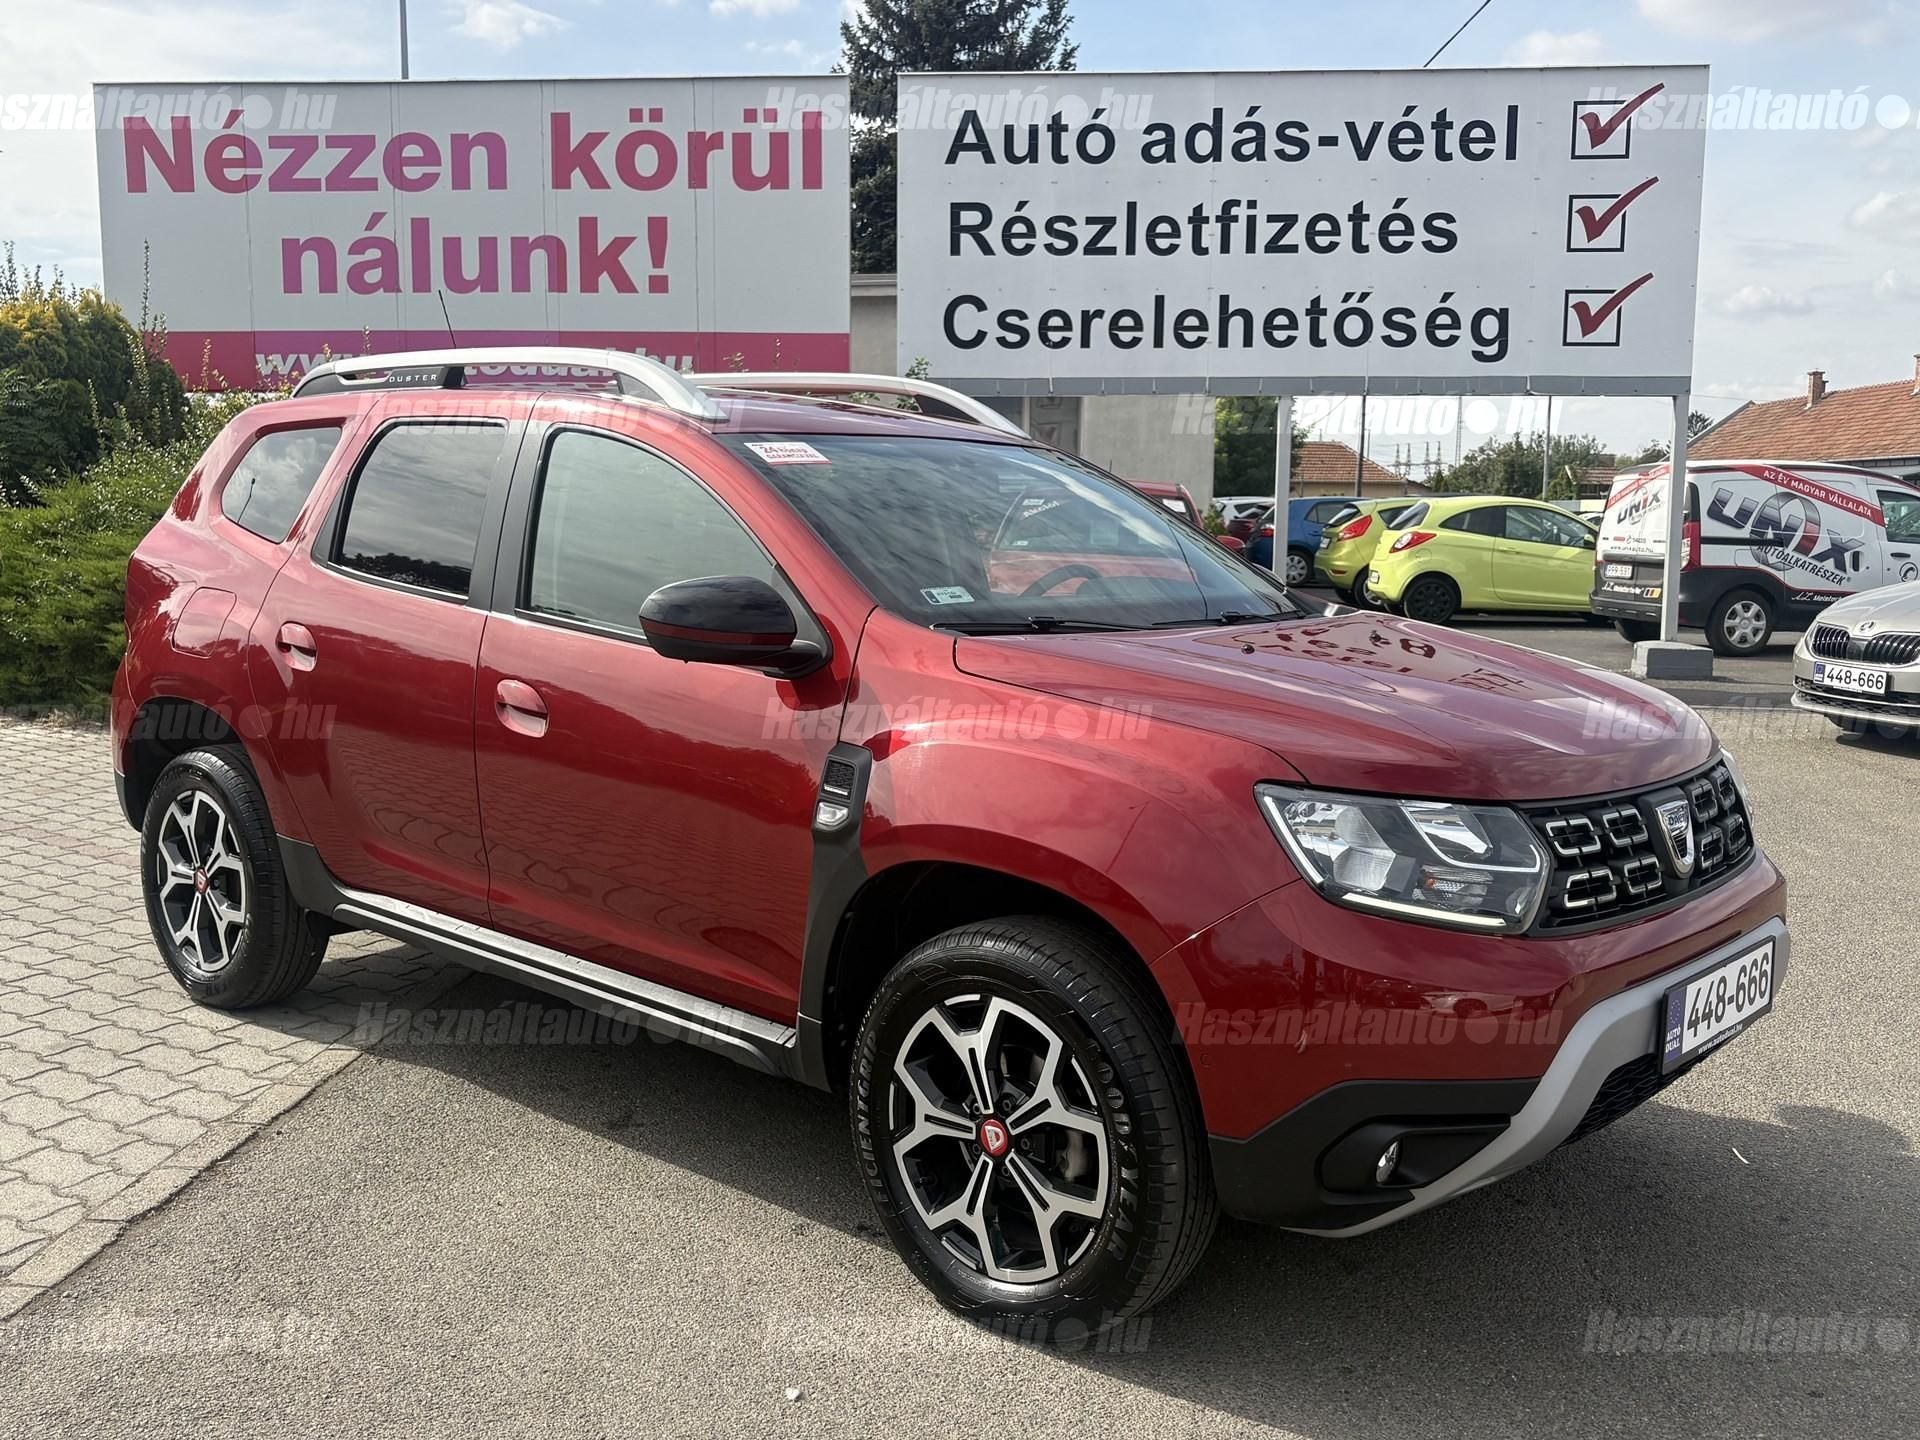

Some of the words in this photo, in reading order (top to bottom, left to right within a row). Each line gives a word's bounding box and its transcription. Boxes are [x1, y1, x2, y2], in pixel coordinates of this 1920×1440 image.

[125, 109, 506, 193] Nézzen
[552, 108, 822, 192] körül
[945, 107, 1116, 166] Autó
[1140, 104, 1519, 165] adás-vétel
[283, 211, 669, 295] nálunk!
[949, 196, 1459, 258] Részletfizetés
[942, 291, 1510, 363] Cserelehetőség
[388, 373, 438, 384] DUSTER
[1763, 469, 1776, 480] AZ
[1777, 470, 1790, 485] ÉV
[1791, 480, 1826, 499] MAGYAR
[1828, 492, 1872, 517] VÁLLALATA
[1826, 667, 1885, 690] 448-666
[1687, 951, 1770, 1038] 448-666
[1665, 1037, 1681, 1054] DUAL
